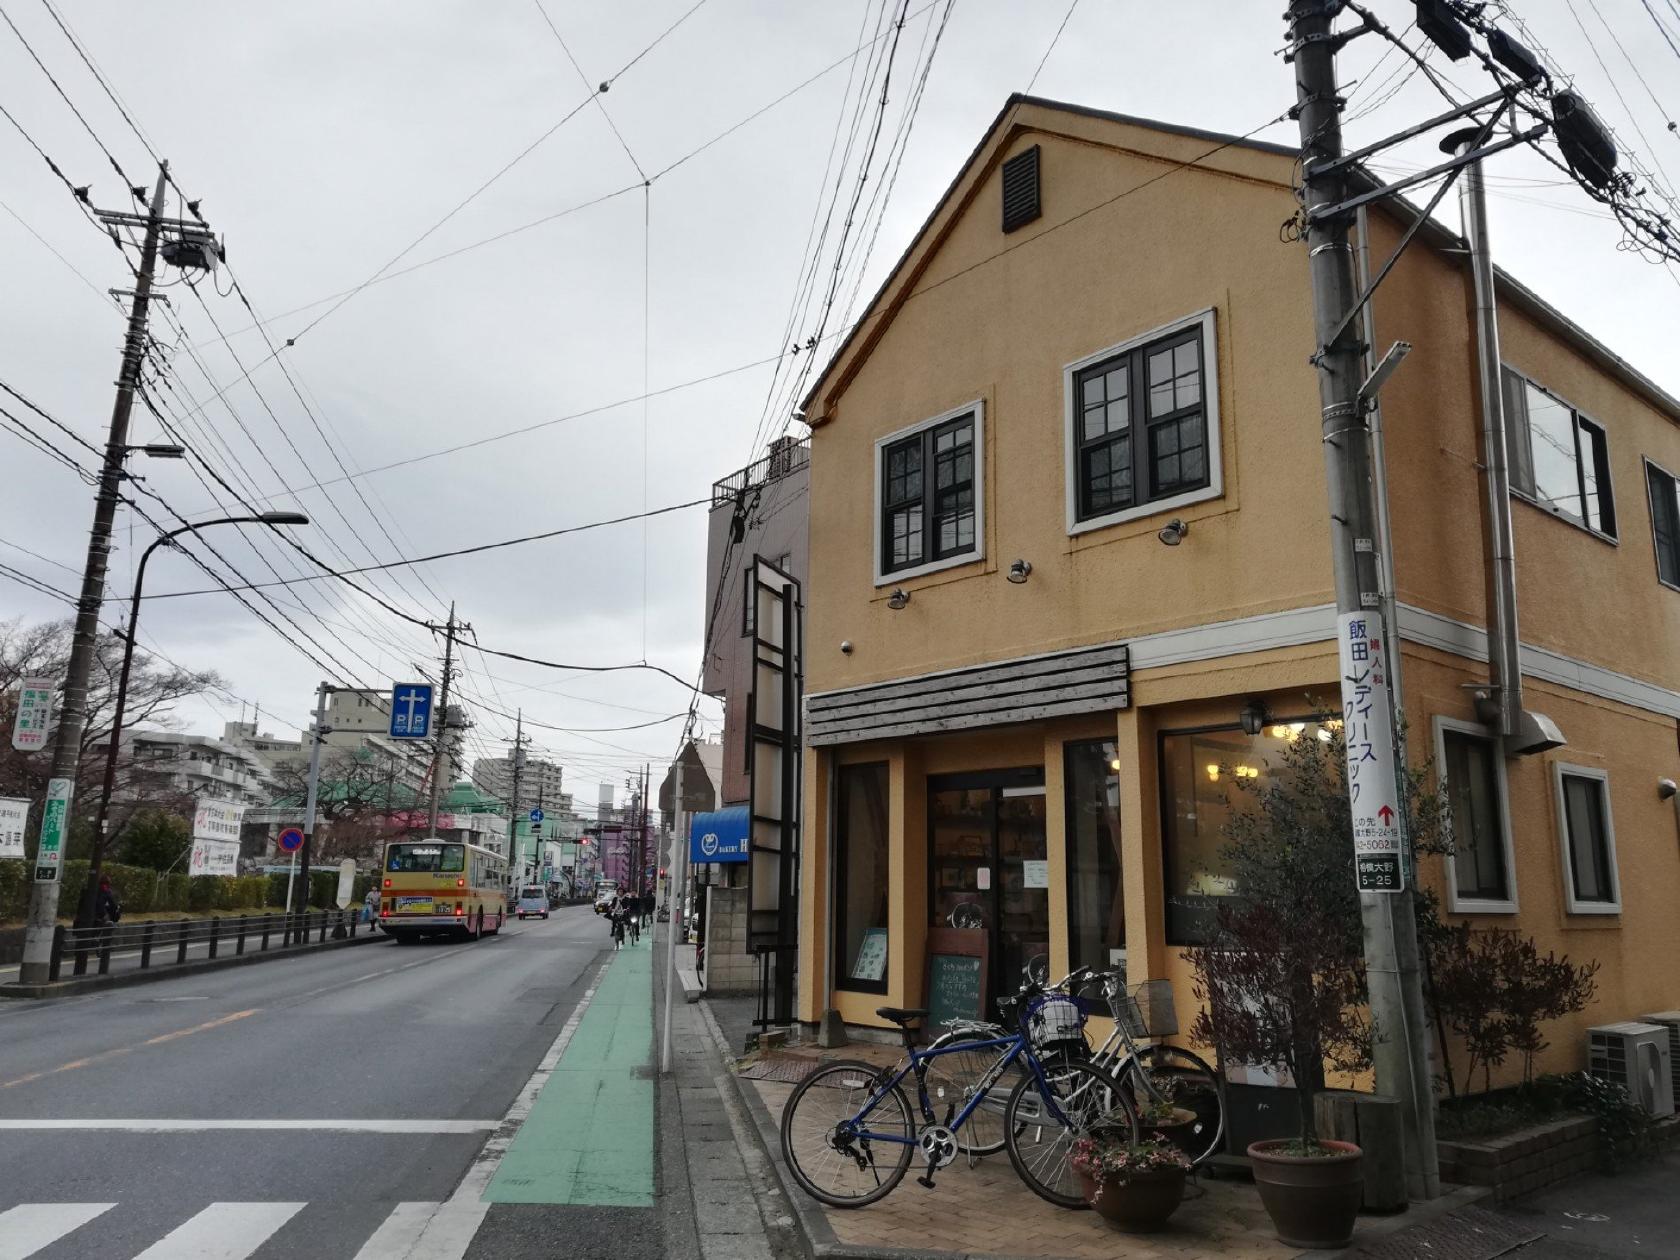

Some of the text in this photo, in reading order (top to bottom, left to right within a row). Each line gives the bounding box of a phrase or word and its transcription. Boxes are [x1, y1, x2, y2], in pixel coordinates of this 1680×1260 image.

[1345, 620, 1377, 761] 飯田レディース
[1346, 701, 1360, 803] クリニック
[1360, 862, 1394, 873] 相模大野
[1362, 875, 1392, 885] 5-25
